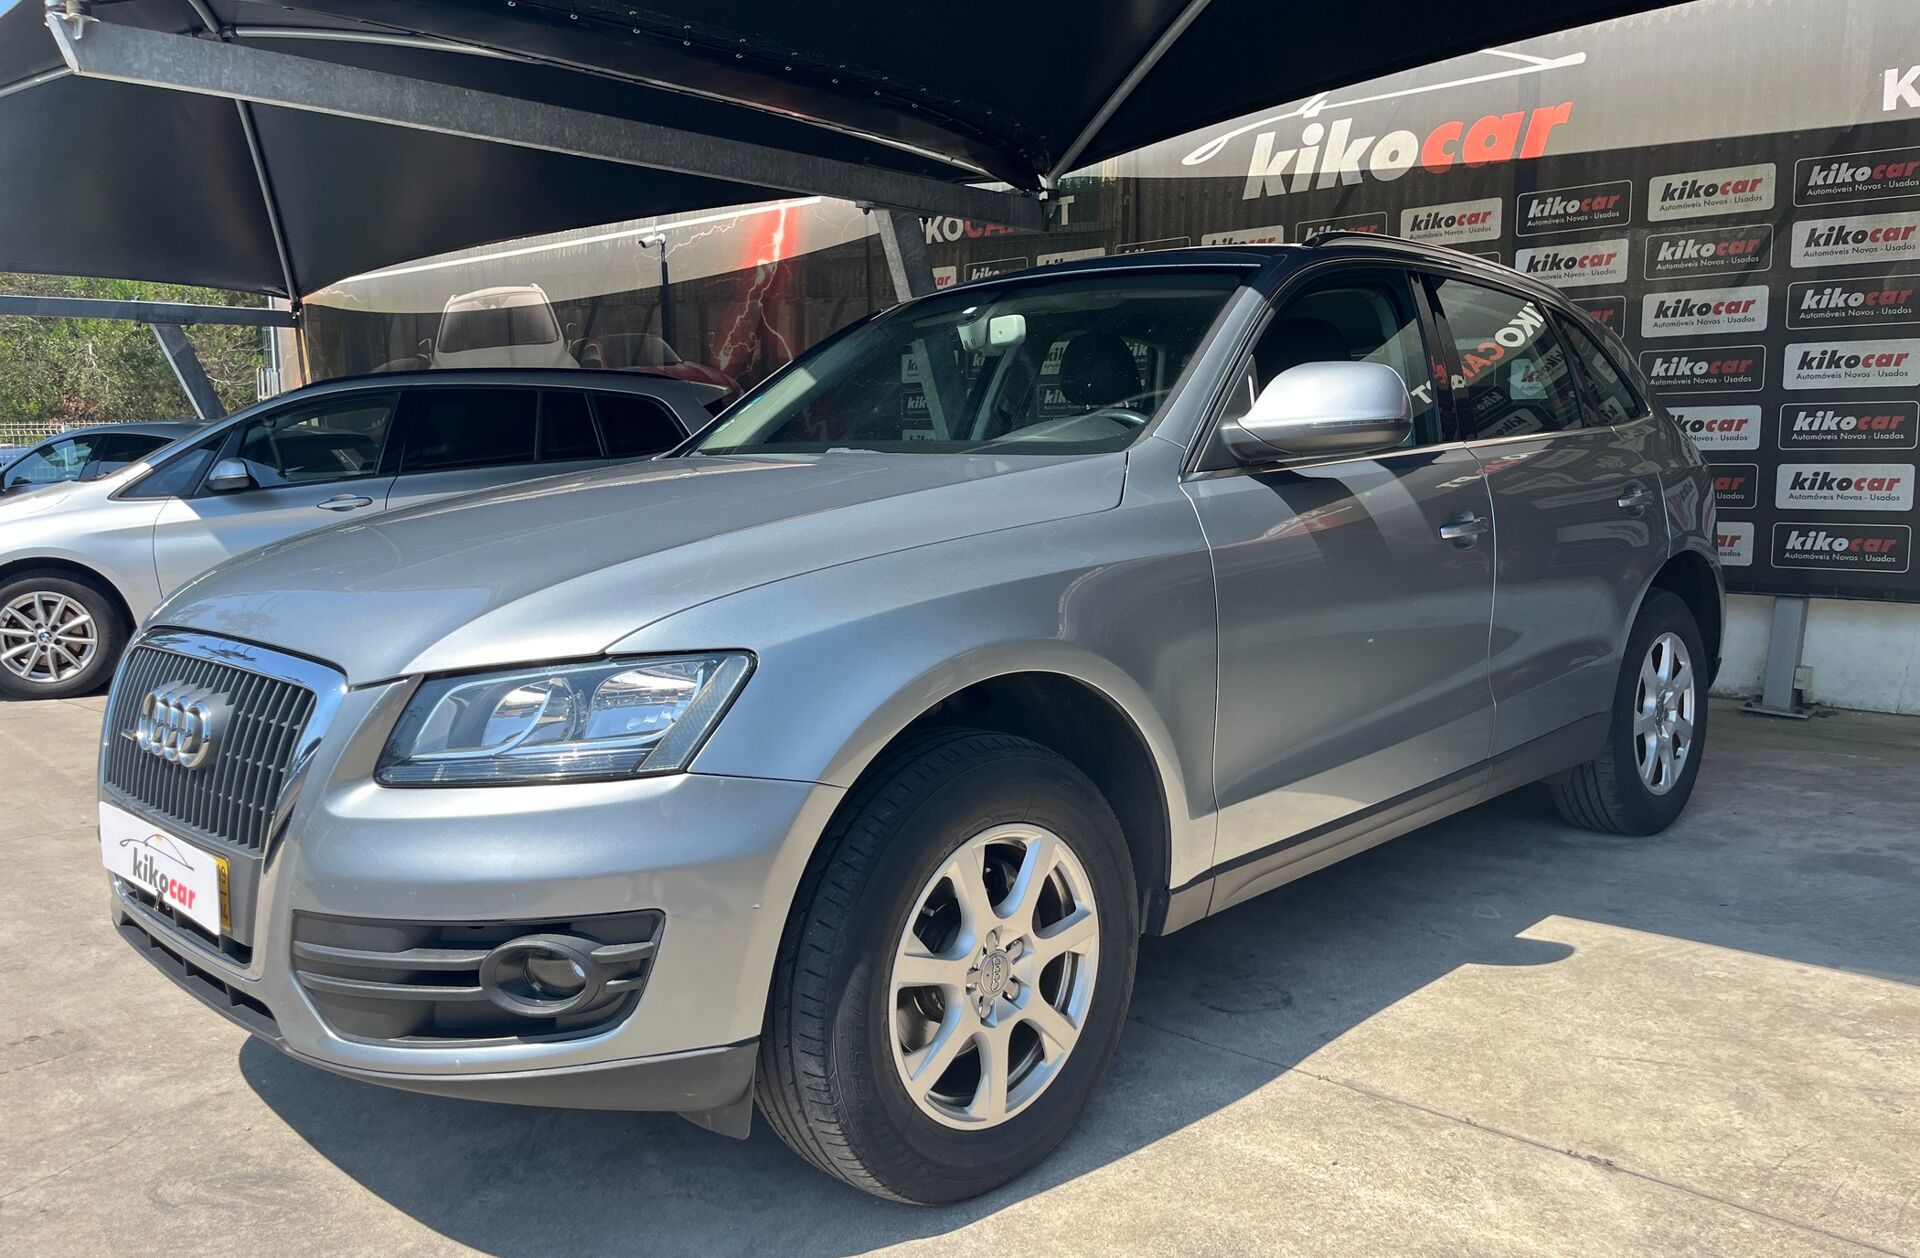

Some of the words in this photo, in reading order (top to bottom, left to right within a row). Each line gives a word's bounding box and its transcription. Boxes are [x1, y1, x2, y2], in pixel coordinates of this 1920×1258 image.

[1242, 102, 1573, 200] kikocar
[1808, 160, 1920, 186] kikocar
[1661, 178, 1763, 202] kikocar
[1806, 186, 1852, 196] Automóveis
[1889, 179, 1920, 188] Usados
[1528, 194, 1621, 218] kikocar
[1660, 202, 1701, 211] Automóveis
[1734, 194, 1762, 204] Usados
[1410, 210, 1492, 232] kikocar
[1526, 216, 1565, 227] Automóveis
[1566, 213, 1588, 222] Novos
[1594, 210, 1620, 219] Usados
[1805, 225, 1917, 248] kikocar
[1657, 236, 1760, 261] kikocar
[1804, 248, 1849, 257] Automóveis
[1852, 246, 1878, 254] Novos
[1885, 242, 1916, 252] Usados
[1526, 252, 1617, 273] kikocar
[1656, 260, 1698, 270] Automóveis
[1700, 258, 1724, 266] Novos
[1731, 255, 1759, 264] Usados
[1564, 270, 1585, 279] Novos
[1592, 268, 1617, 277] Usados
[1654, 298, 1756, 319] kikocar
[1800, 288, 1913, 309] kikocar
[1882, 306, 1912, 315] Usados
[1653, 320, 1694, 328] Automóveis
[1728, 315, 1755, 324] Usados
[1650, 356, 1752, 376] kikocar
[1797, 350, 1910, 370] kikocar
[1724, 374, 1752, 383] Usados
[1796, 372, 1841, 380] Automóveis
[1878, 369, 1908, 377] Usados
[1793, 410, 1905, 431] kikocar
[1874, 431, 1904, 440] Usados
[1790, 471, 1901, 491] kikocar
[1870, 493, 1900, 501] Usados
[1785, 530, 1897, 552] kikocar
[1784, 552, 1830, 560] Automóveis
[1832, 553, 1858, 561] Novos
[1865, 554, 1896, 563] Usados
[132, 847, 196, 910] kikocar
